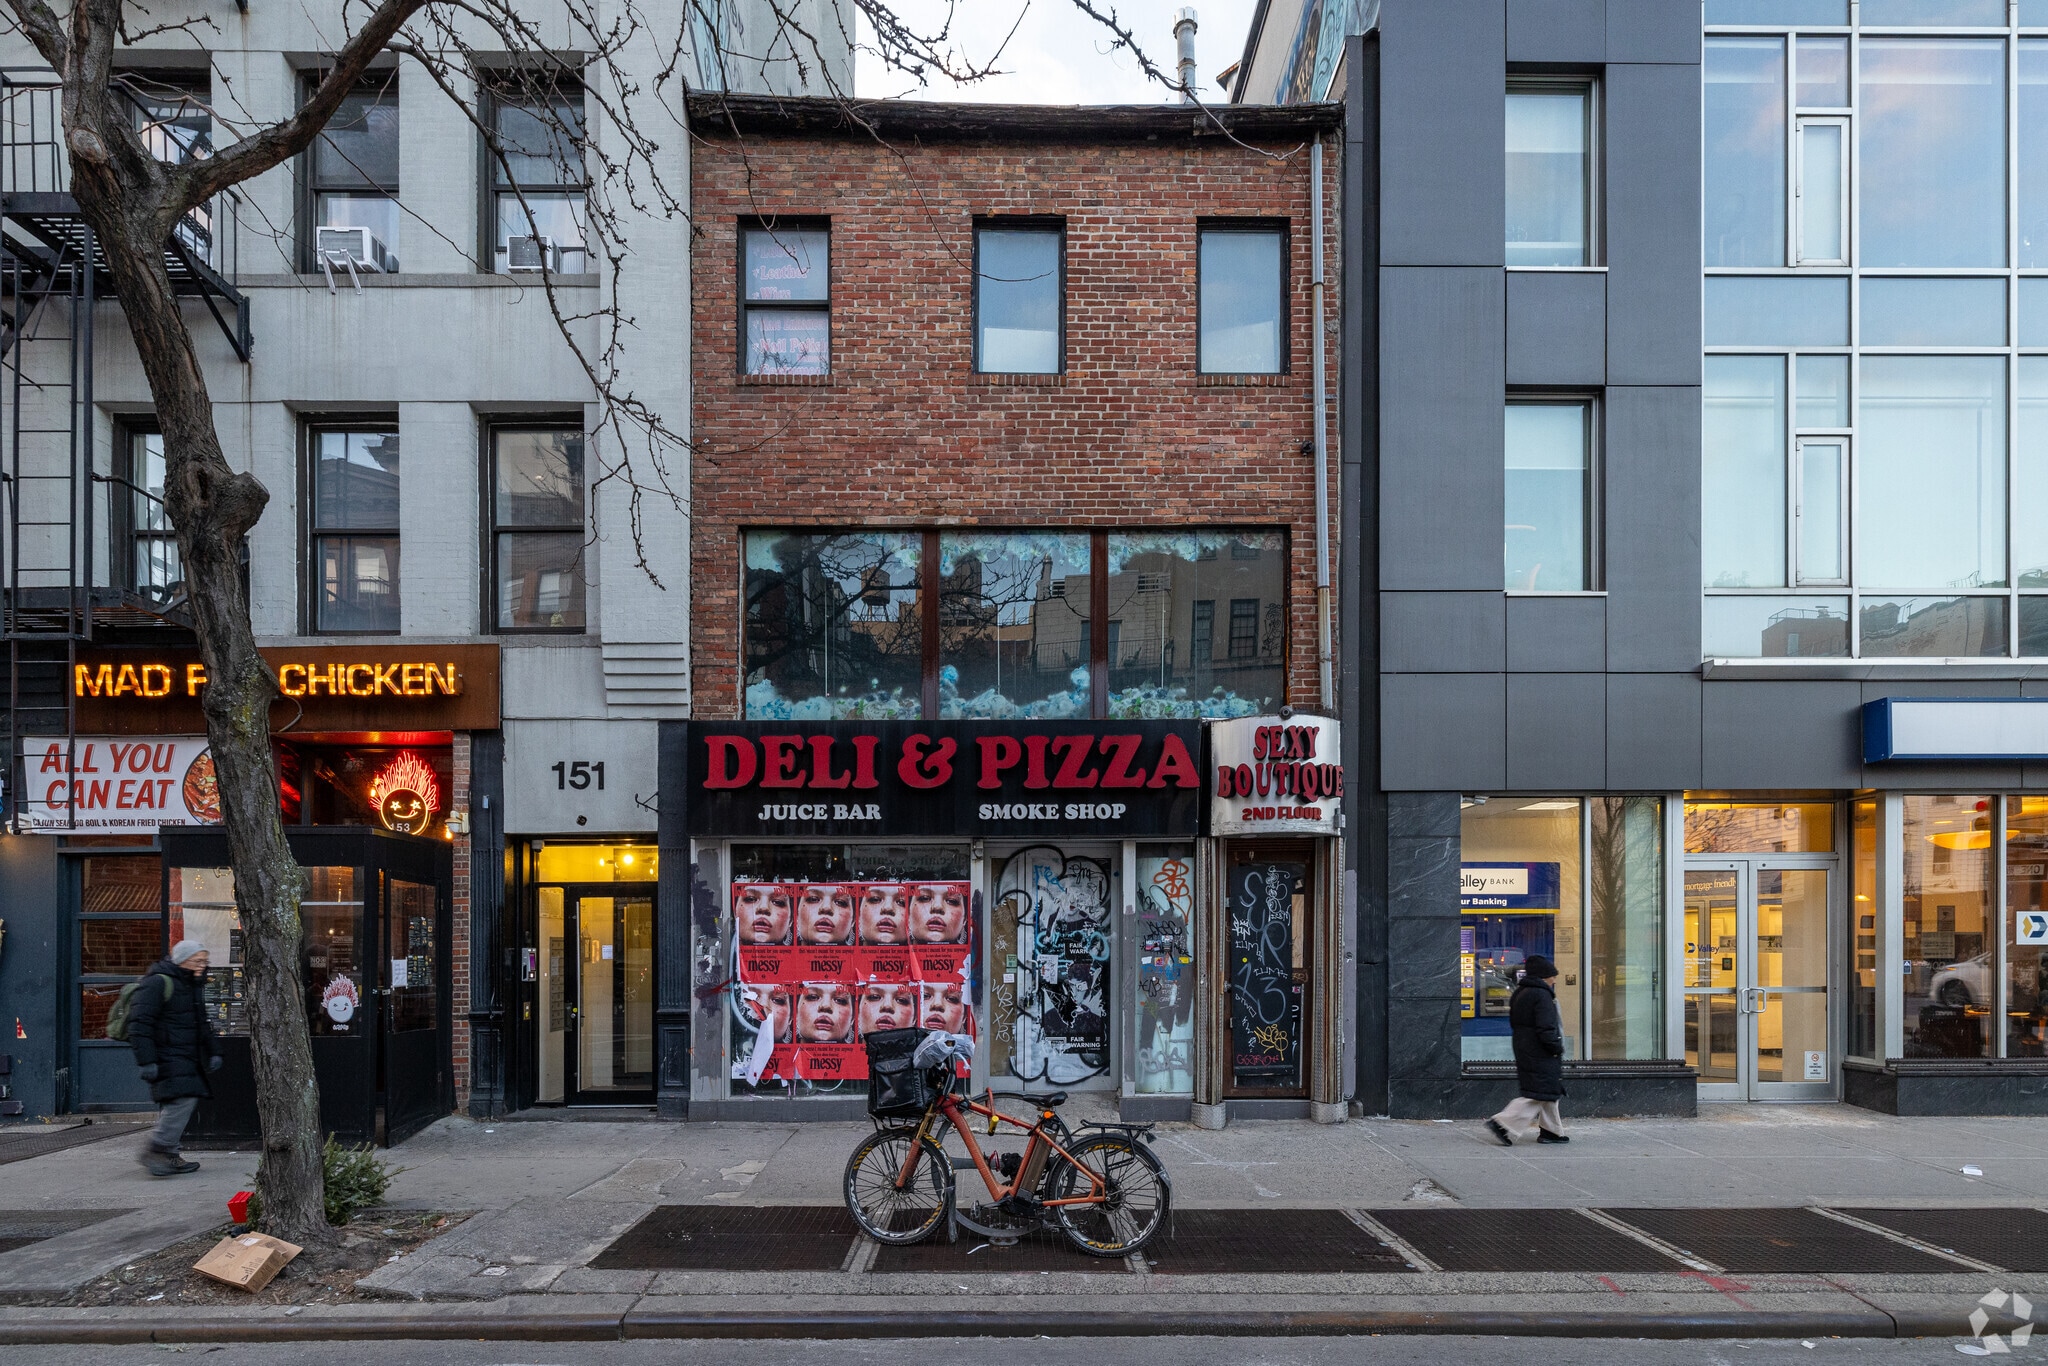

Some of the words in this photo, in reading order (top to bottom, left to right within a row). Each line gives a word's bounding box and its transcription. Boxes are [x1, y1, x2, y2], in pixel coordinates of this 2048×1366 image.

[760, 265, 808, 280] Leather
[75, 664, 170, 697] MAD
[279, 662, 456, 696] CHICKEN
[1253, 725, 1320, 760] SEXY
[40, 743, 99, 773] ALL
[109, 743, 176, 773] YOU
[703, 734, 877, 789] DELI
[898, 733, 958, 789] &
[975, 732, 1201, 789] PIZZA
[551, 761, 605, 790] 151
[1217, 761, 1344, 803] BOUTIQUE
[45, 779, 112, 810] CAN
[115, 779, 176, 810] EAT
[758, 803, 828, 820] JUICE
[833, 803, 882, 820] BAR
[978, 803, 1060, 820] SMOKE
[1064, 803, 1127, 820] SHOP
[1241, 806, 1276, 821] 2ND
[1277, 805, 1322, 821] FLOOR
[32, 818, 55, 827] CAJUN
[55, 819, 84, 827] SEAOD
[85, 819, 101, 827] BOIL
[102, 819, 108, 827] &
[109, 818, 136, 827] KOREAN
[137, 818, 156, 827] FRIED
[157, 818, 186, 827] CHICKEN
[391, 823, 410, 832] 153
[1461, 874, 1487, 891] alley
[1684, 882, 1713, 892] mortgage
[1472, 898, 1507, 906] Banking
[1697, 943, 1720, 955] Valley
